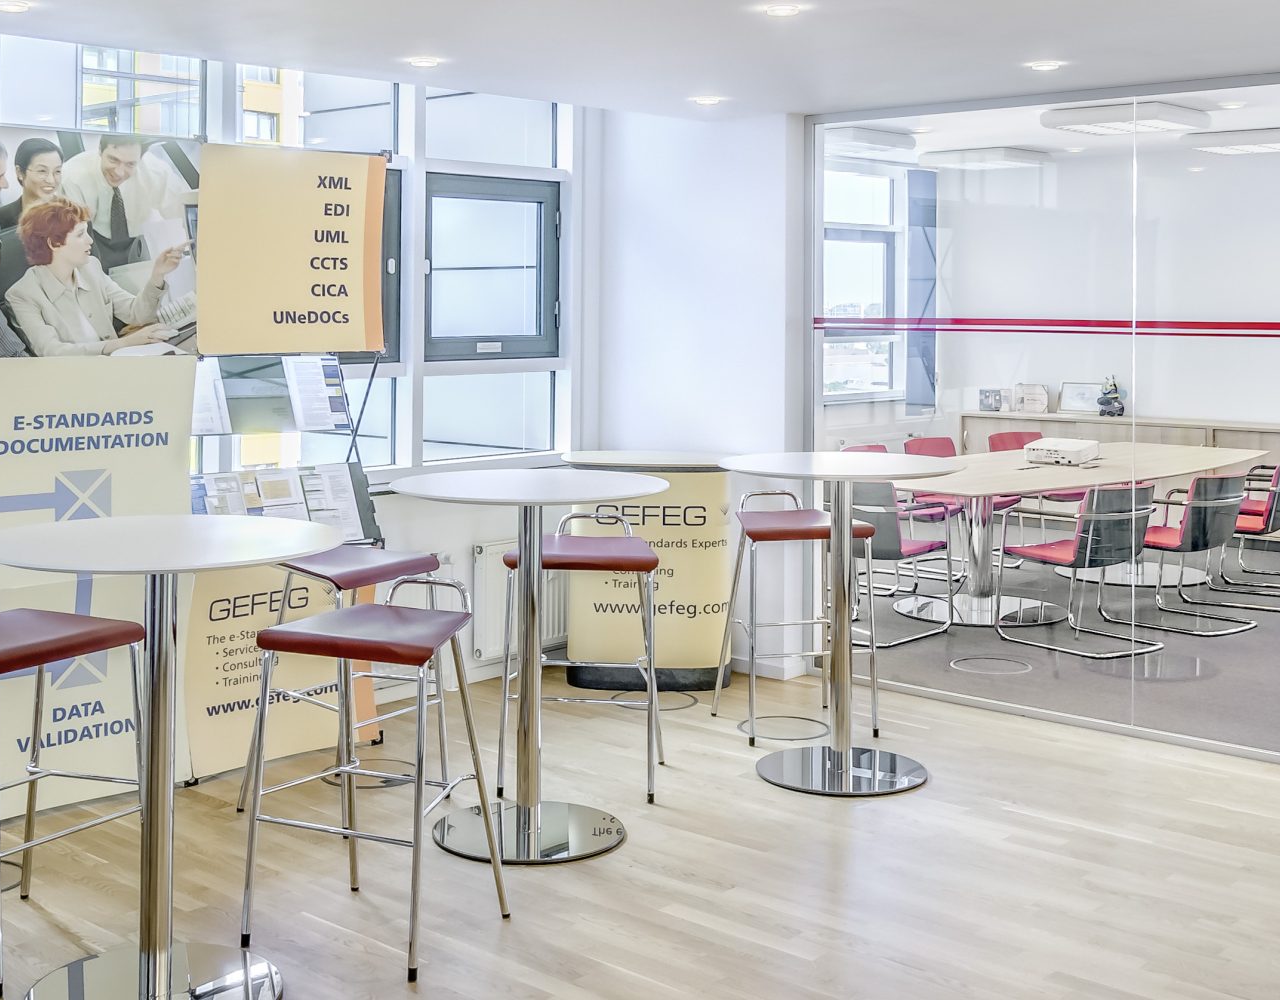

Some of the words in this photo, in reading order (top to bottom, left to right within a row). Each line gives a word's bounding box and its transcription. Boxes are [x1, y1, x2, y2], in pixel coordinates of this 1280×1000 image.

[317, 175, 352, 190] XML
[324, 203, 350, 217] EDI
[314, 229, 349, 244] UML
[310, 256, 348, 270] CCTS
[311, 283, 349, 297] CICA
[273, 310, 350, 325] UNeDOCs
[13, 410, 154, 431] E-STANDARDS
[596, 504, 707, 527] GEFEG
[647, 538, 688, 548] ndards
[691, 538, 727, 550] Experts
[209, 586, 309, 622] GEFEG
[206, 634, 226, 646] The
[222, 643, 263, 658] Service
[222, 673, 262, 687] Trainin
[52, 700, 105, 723] DATA
